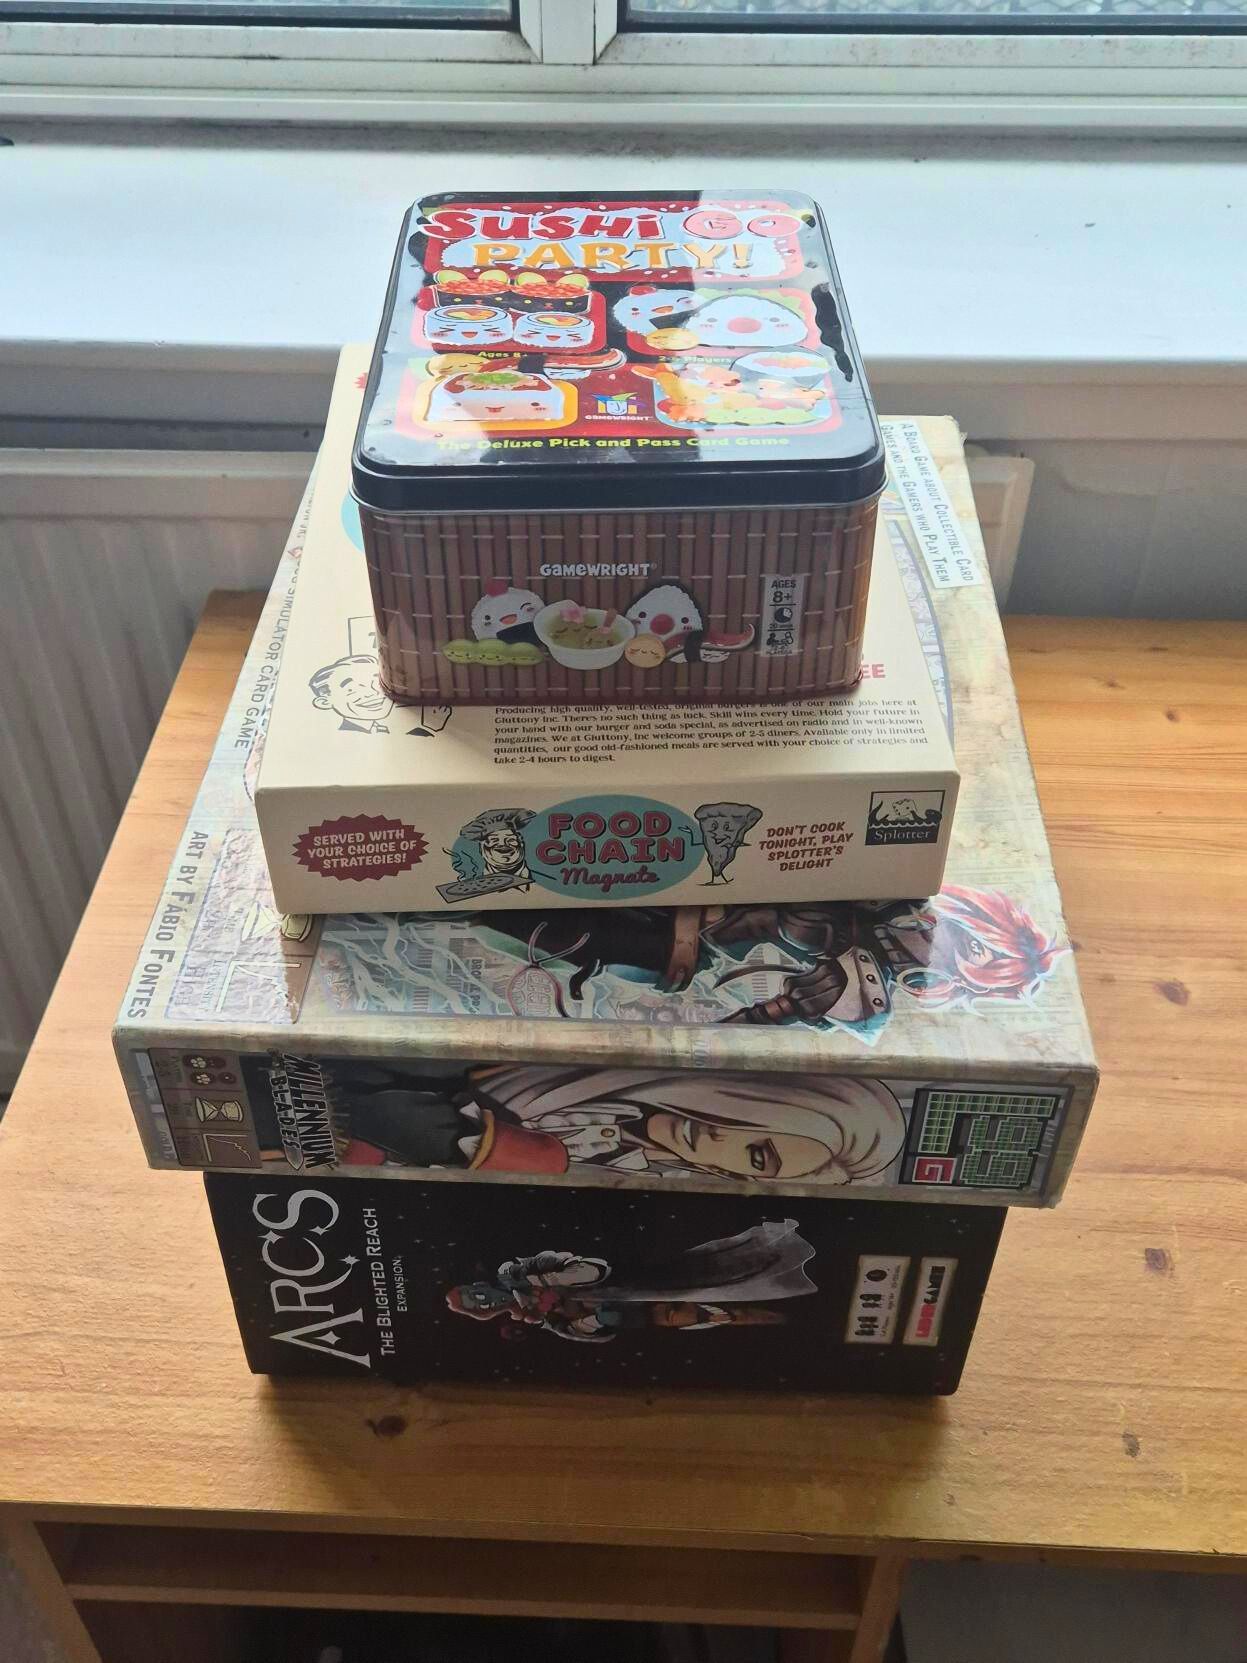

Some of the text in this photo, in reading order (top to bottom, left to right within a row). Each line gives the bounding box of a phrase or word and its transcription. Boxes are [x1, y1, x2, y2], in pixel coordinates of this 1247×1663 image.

[472, 242, 753, 270] PARTY!
[477, 351, 509, 360] Ages
[437, 437, 790, 450] The Deluxe Pick and Pass Card Game
[771, 579, 797, 589] AGES
[772, 590, 793, 603] 8+
[250, 664, 274, 704] CARD
[495, 705, 546, 714] Producing
[550, 705, 571, 713] high
[859, 699, 879, 707] jobs
[494, 716, 540, 724] Gluttony
[615, 712, 639, 721] such
[641, 713, 667, 721] thing
[760, 711, 788, 719] every
[234, 706, 261, 749] GAME
[494, 726, 519, 736] your
[597, 724, 629, 733] burger
[731, 719, 783, 728] advertised
[697, 730, 733, 739] groups
[851, 728, 873, 736] only
[574, 744, 599, 753] good
[601, 742, 669, 751] old-fashioned
[671, 741, 700, 749] meals
[720, 740, 754, 748] served
[757, 739, 780, 747] with
[782, 740, 806, 748] your
[856, 737, 908, 746] strategies
[494, 756, 518, 764] take
[548, 811, 672, 839] FOOD
[766, 821, 846, 838] DON'T COOK
[313, 828, 405, 846] SERVED WITH
[759, 832, 854, 850] TONIGHT, PLAY
[874, 829, 930, 842] Splotter
[185, 831, 209, 860] ART
[307, 840, 417, 858] YOUR CHOICE OF
[536, 836, 686, 865] CHAIN
[768, 845, 845, 862] SPLOTTER'S
[323, 853, 407, 869] STRATEGIES!
[779, 858, 834, 872] DELIGHT
[176, 864, 198, 885] BY
[560, 865, 660, 892] Magnate
[126, 948, 174, 1018] FONTES
[268, 1074, 300, 1151] BLADES
[283, 1052, 337, 1170] MILLENNIUM
[252, 1189, 371, 1368] ARCS
[362, 1207, 396, 1356] THE BLIGHTED REACH
[392, 1258, 408, 1312] EXPANSION
